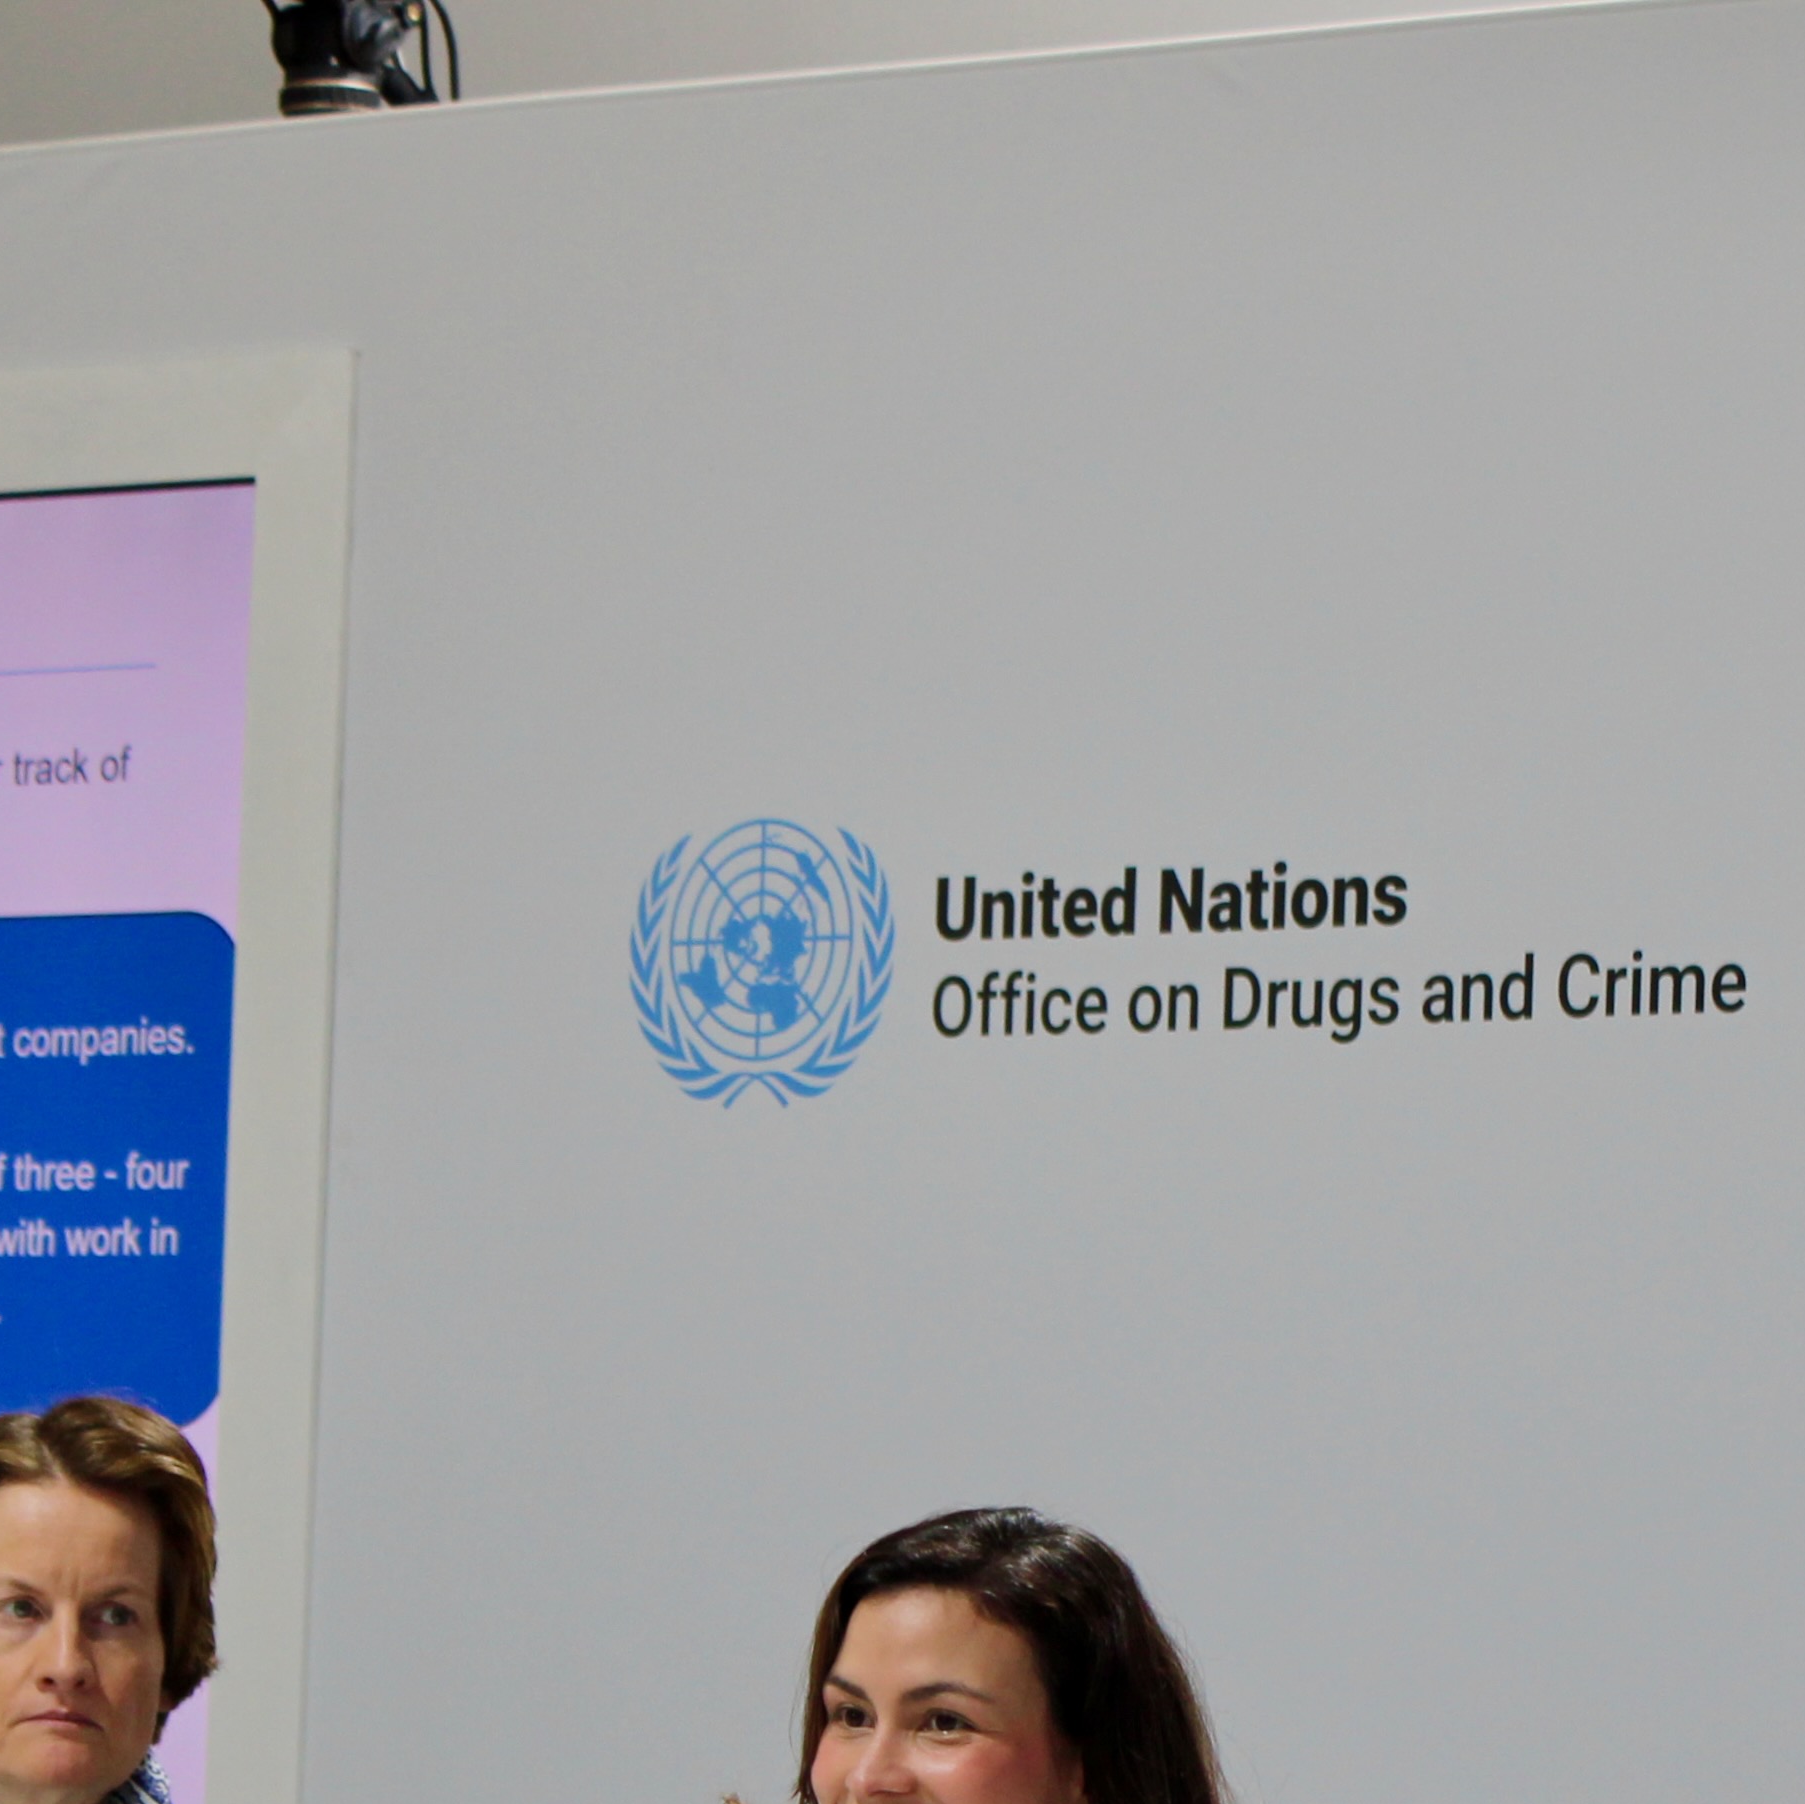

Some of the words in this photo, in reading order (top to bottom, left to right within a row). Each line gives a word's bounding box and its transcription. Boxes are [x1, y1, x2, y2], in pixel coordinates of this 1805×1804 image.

[14, 748, 88, 785] track
[100, 745, 132, 782] of
[936, 867, 1137, 941] United
[1160, 861, 1407, 933] Nations
[933, 970, 1107, 1037] Office
[1129, 984, 1198, 1032] on
[1224, 967, 1399, 1043] Drugs
[1423, 953, 1534, 1023] and
[1559, 950, 1746, 1018] Crime
[13, 1017, 194, 1065] companies.
[13, 1153, 96, 1191] three
[125, 1151, 190, 1190] four
[64, 1218, 141, 1256] work
[150, 1218, 179, 1255] in
